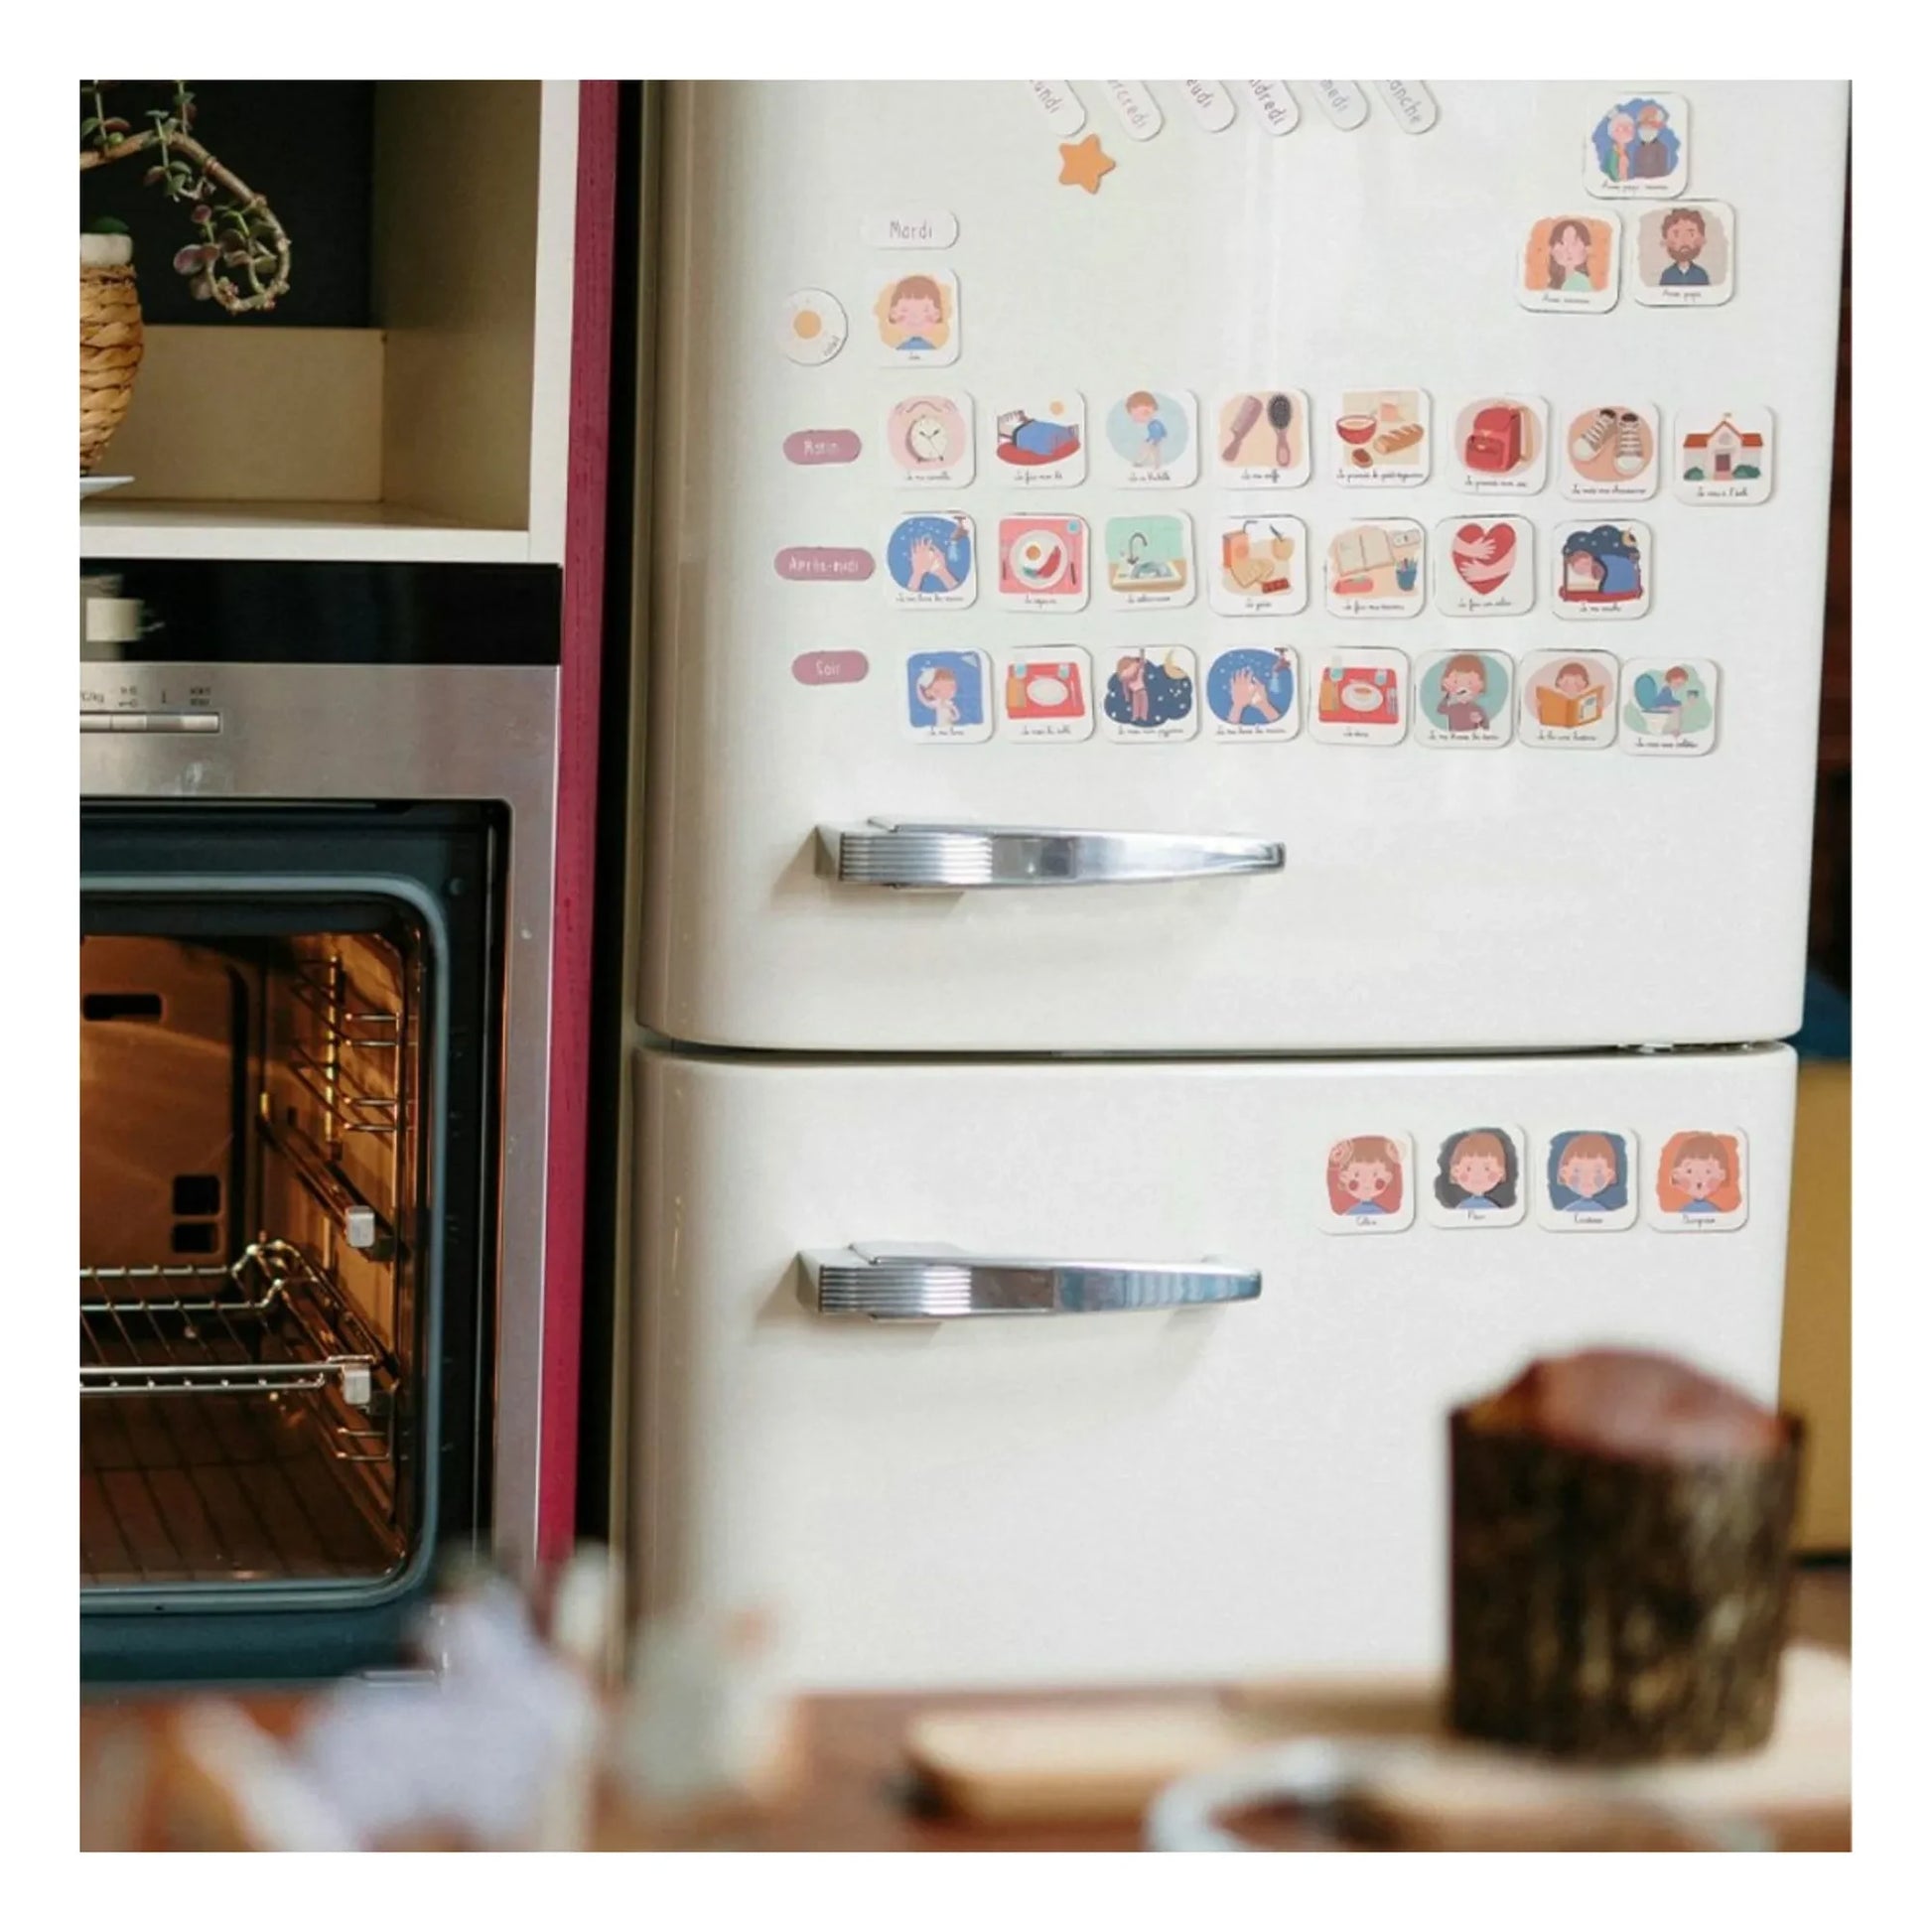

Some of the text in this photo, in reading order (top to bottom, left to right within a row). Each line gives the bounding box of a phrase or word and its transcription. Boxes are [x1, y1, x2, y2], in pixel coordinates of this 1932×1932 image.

[1029, 80, 1062, 113] undi
[890, 219, 932, 239] Mardi
[816, 659, 841, 676] Soir
